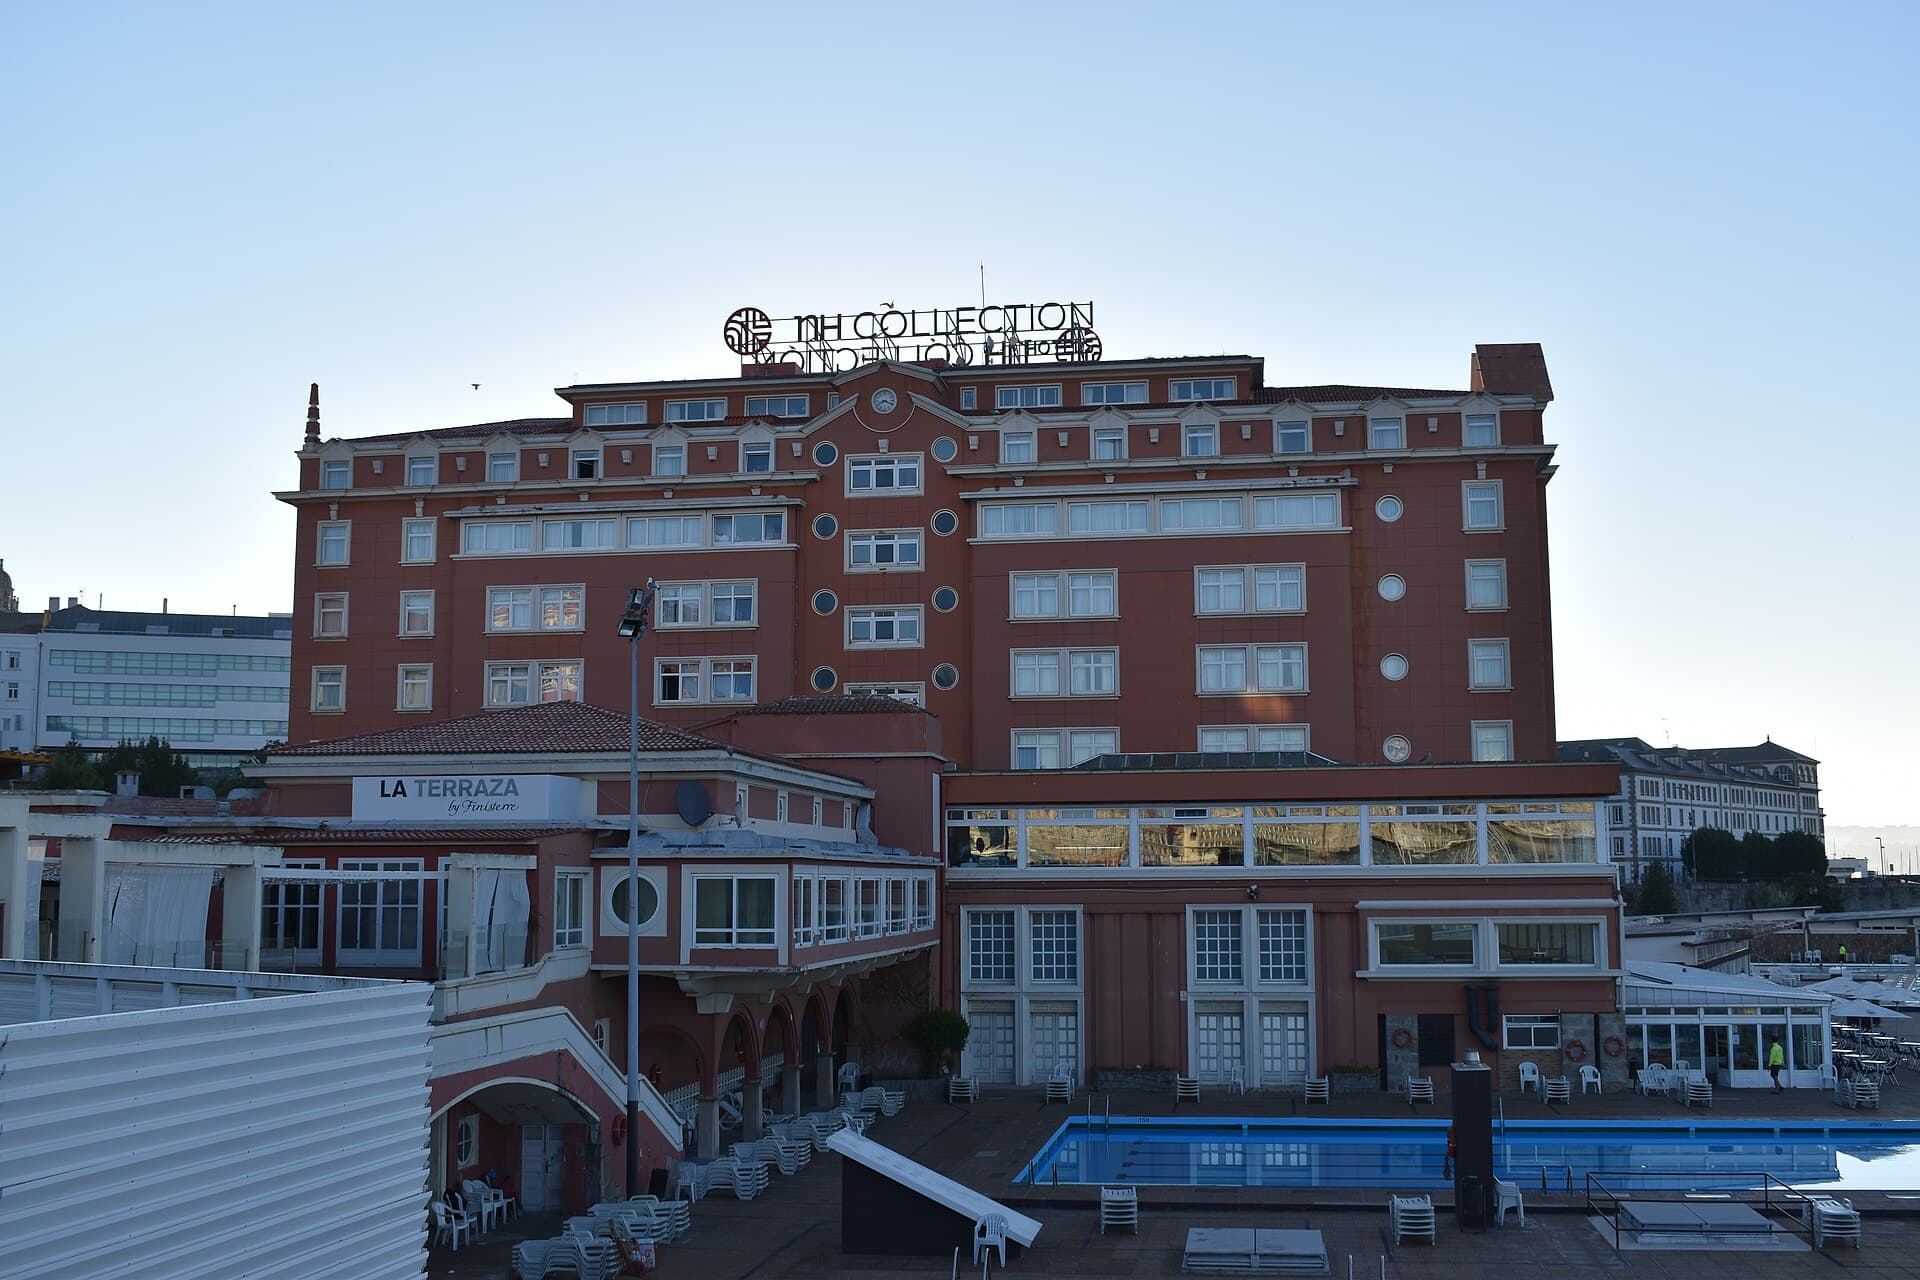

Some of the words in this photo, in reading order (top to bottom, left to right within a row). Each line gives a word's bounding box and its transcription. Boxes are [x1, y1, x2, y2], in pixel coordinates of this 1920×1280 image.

[853, 300, 1094, 339] COLLECTION
[380, 779, 408, 798] LA
[414, 778, 520, 797] TERRAZA
[448, 800, 460, 816] by
[461, 800, 519, 812] Finisterre
